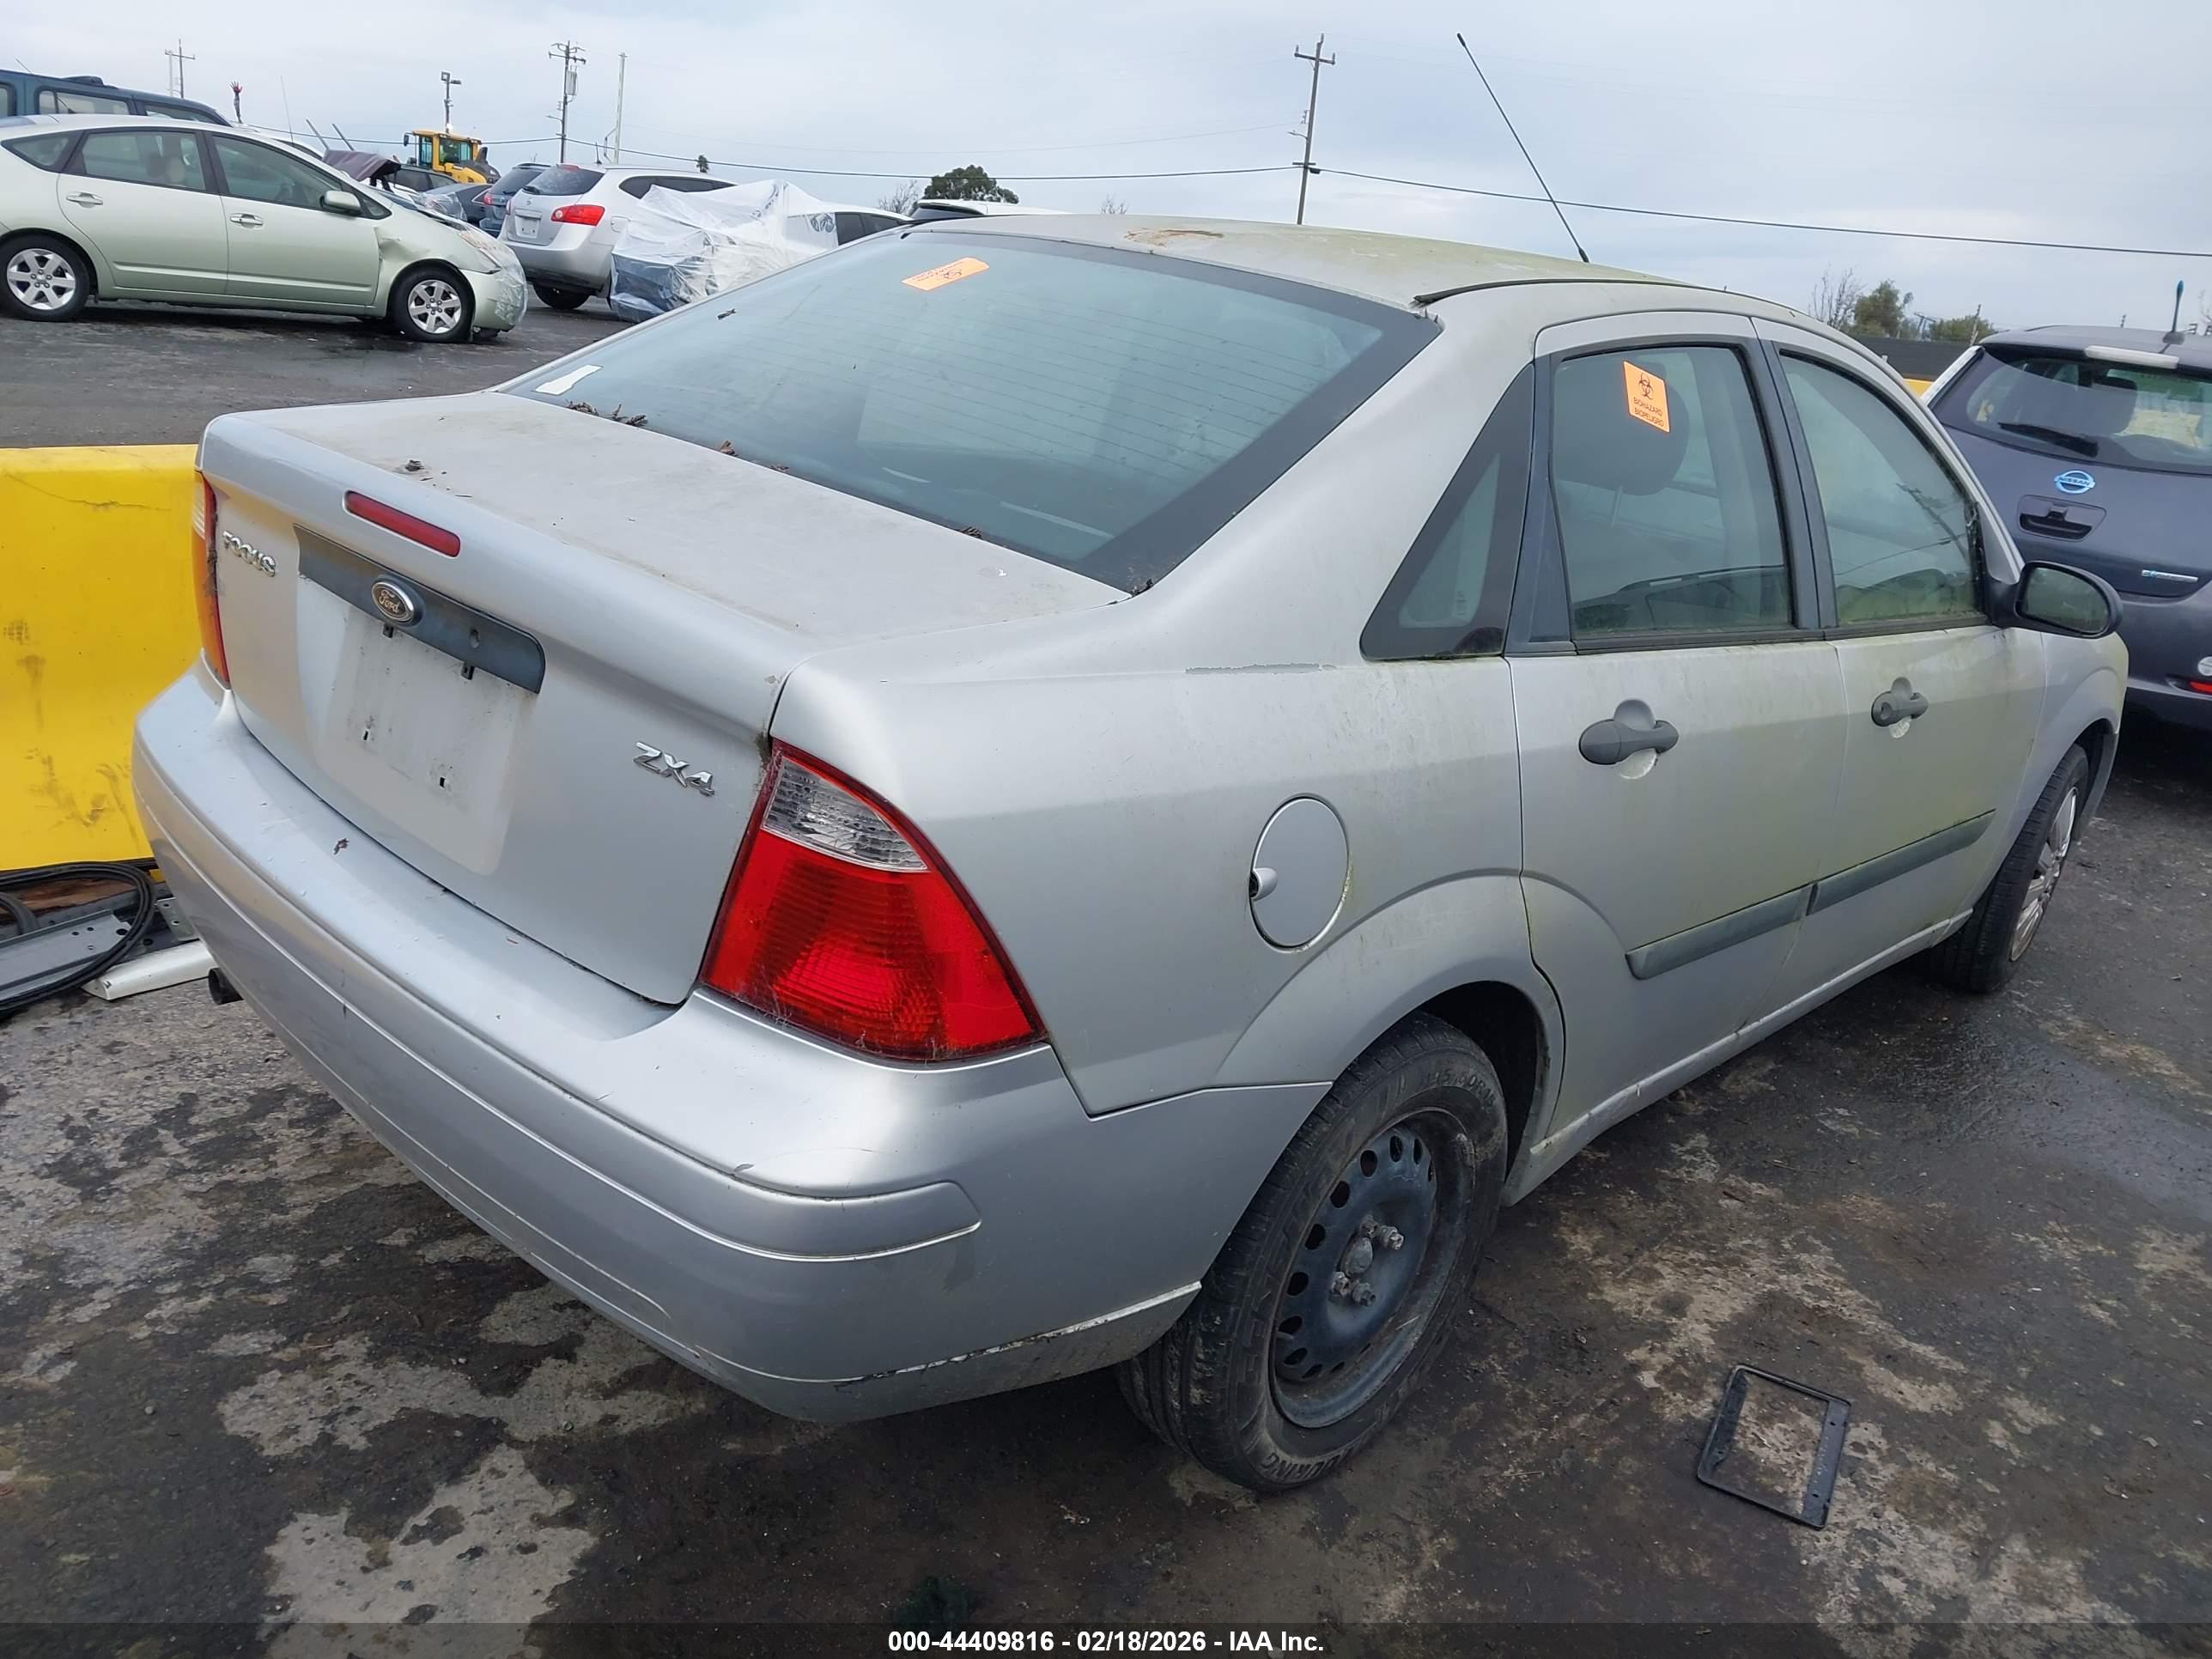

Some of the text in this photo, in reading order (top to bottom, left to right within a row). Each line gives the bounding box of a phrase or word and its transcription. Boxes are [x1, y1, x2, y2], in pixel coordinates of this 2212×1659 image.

[222, 530, 276, 577] FOCUS
[379, 589, 400, 613] Ford
[634, 741, 714, 797] ZX4
